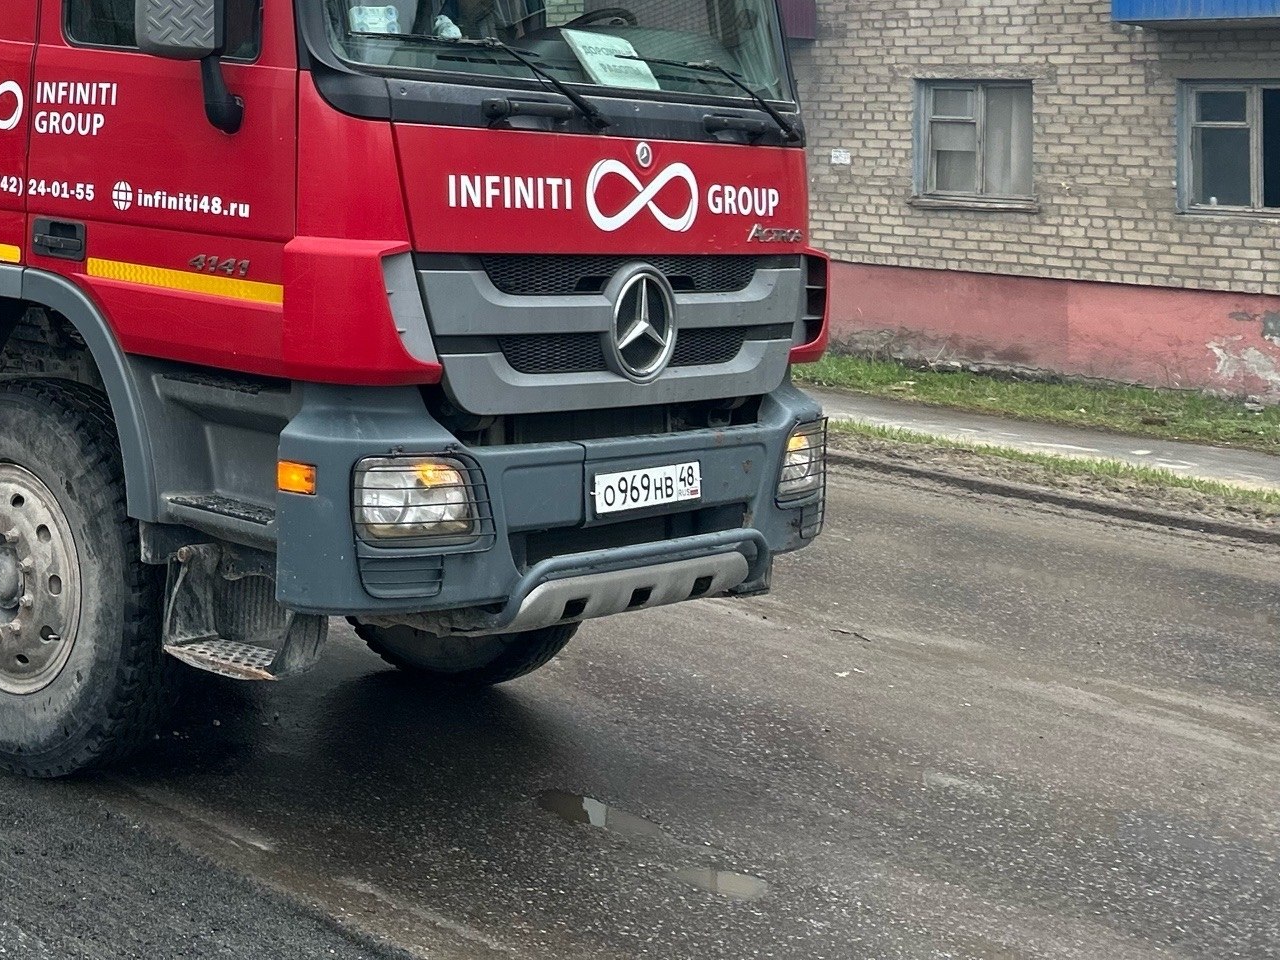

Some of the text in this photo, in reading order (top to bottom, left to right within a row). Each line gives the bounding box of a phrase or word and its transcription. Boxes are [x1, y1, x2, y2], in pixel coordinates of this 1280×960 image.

[36, 81, 118, 106] INFINITI
[34, 111, 105, 136] GROUP
[28, 178, 95, 202] 24-01-55
[448, 174, 779, 217] INFINITI GROUP
[137, 188, 250, 218] infiniti48.ru
[188, 254, 250, 276] 4141
